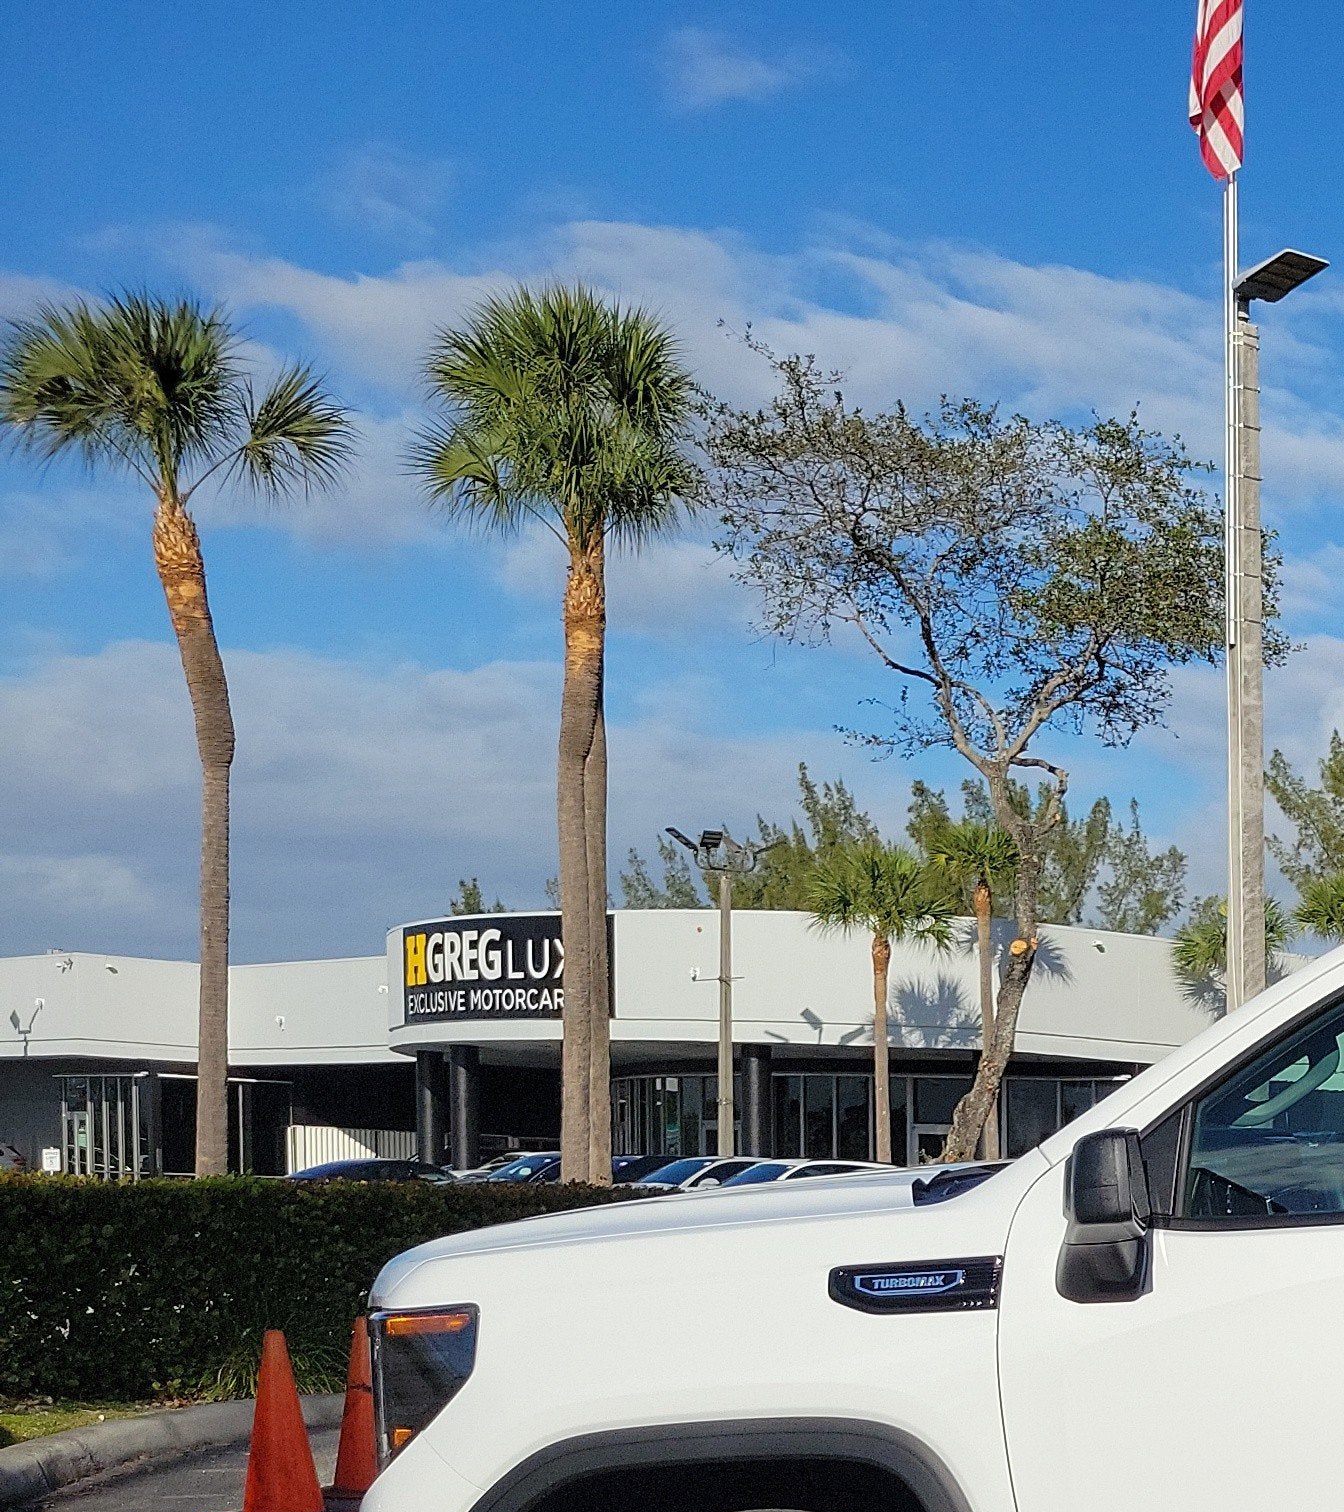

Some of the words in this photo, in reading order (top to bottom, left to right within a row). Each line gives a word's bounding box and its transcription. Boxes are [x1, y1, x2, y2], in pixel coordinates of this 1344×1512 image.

[408, 990, 466, 1015] EXCLUSIVE
[470, 987, 565, 1011] MOTORCAR
[871, 1274, 945, 1290] TURBOMAX
